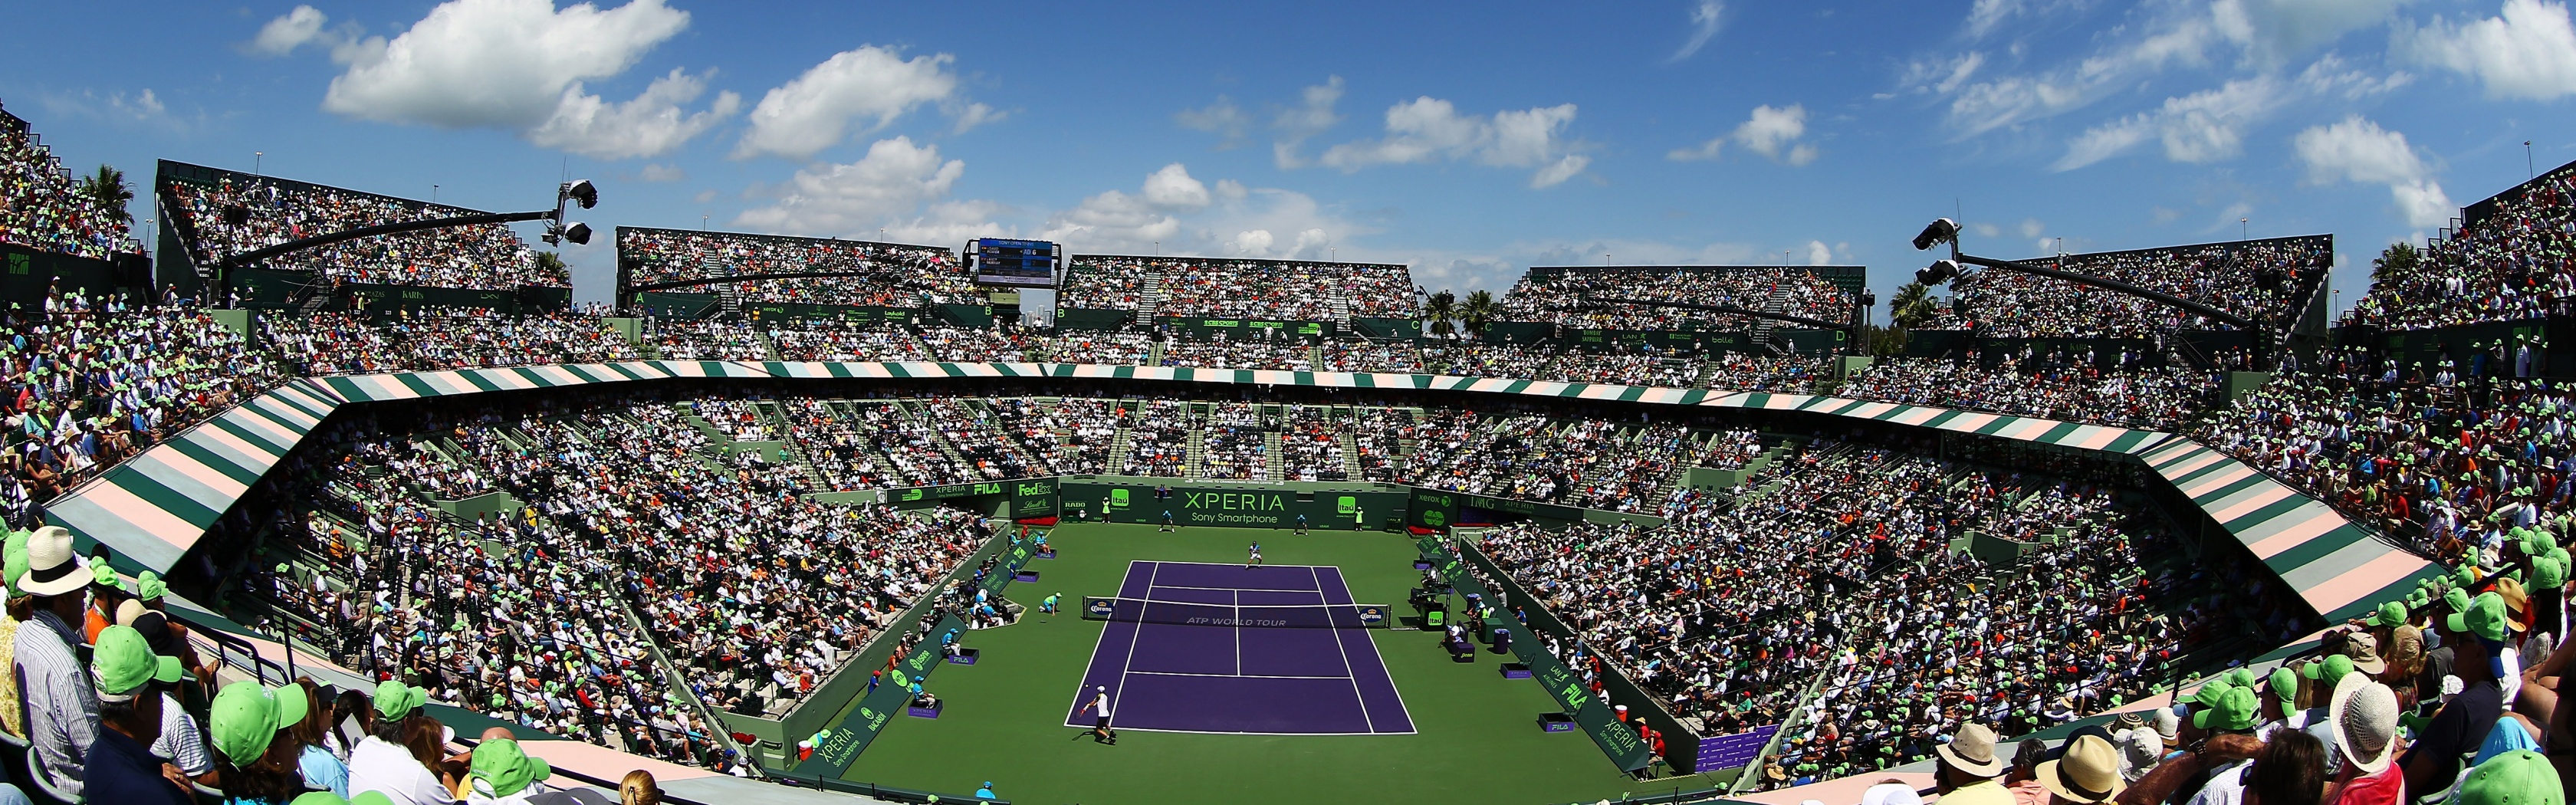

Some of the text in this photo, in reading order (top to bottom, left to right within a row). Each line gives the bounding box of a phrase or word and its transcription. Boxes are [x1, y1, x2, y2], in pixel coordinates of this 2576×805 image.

[564, 290, 570, 300] A
[635, 292, 644, 303] A
[985, 307, 991, 315] B
[1058, 309, 1065, 317] B
[1411, 320, 1419, 330] C
[1485, 322, 1492, 331] C
[1836, 330, 1845, 341] D
[1907, 332, 1914, 342] D
[936, 483, 1001, 495] XPERIA FILA
[1019, 482, 1051, 496] FedEx
[1184, 491, 1285, 511] XPERIA
[1418, 495, 1440, 503] xerox
[1191, 512, 1278, 524] Sony Smartphone
[1550, 665, 1561, 677] LAN
[1543, 674, 1556, 688] AIRLINES
[1562, 683, 1588, 708] FILA
[1605, 718, 1637, 752] XPERIA
[819, 728, 854, 762] XPERIA
[1599, 730, 1624, 756] Sony Smartphone
[833, 739, 860, 767] Sony Smartphone
